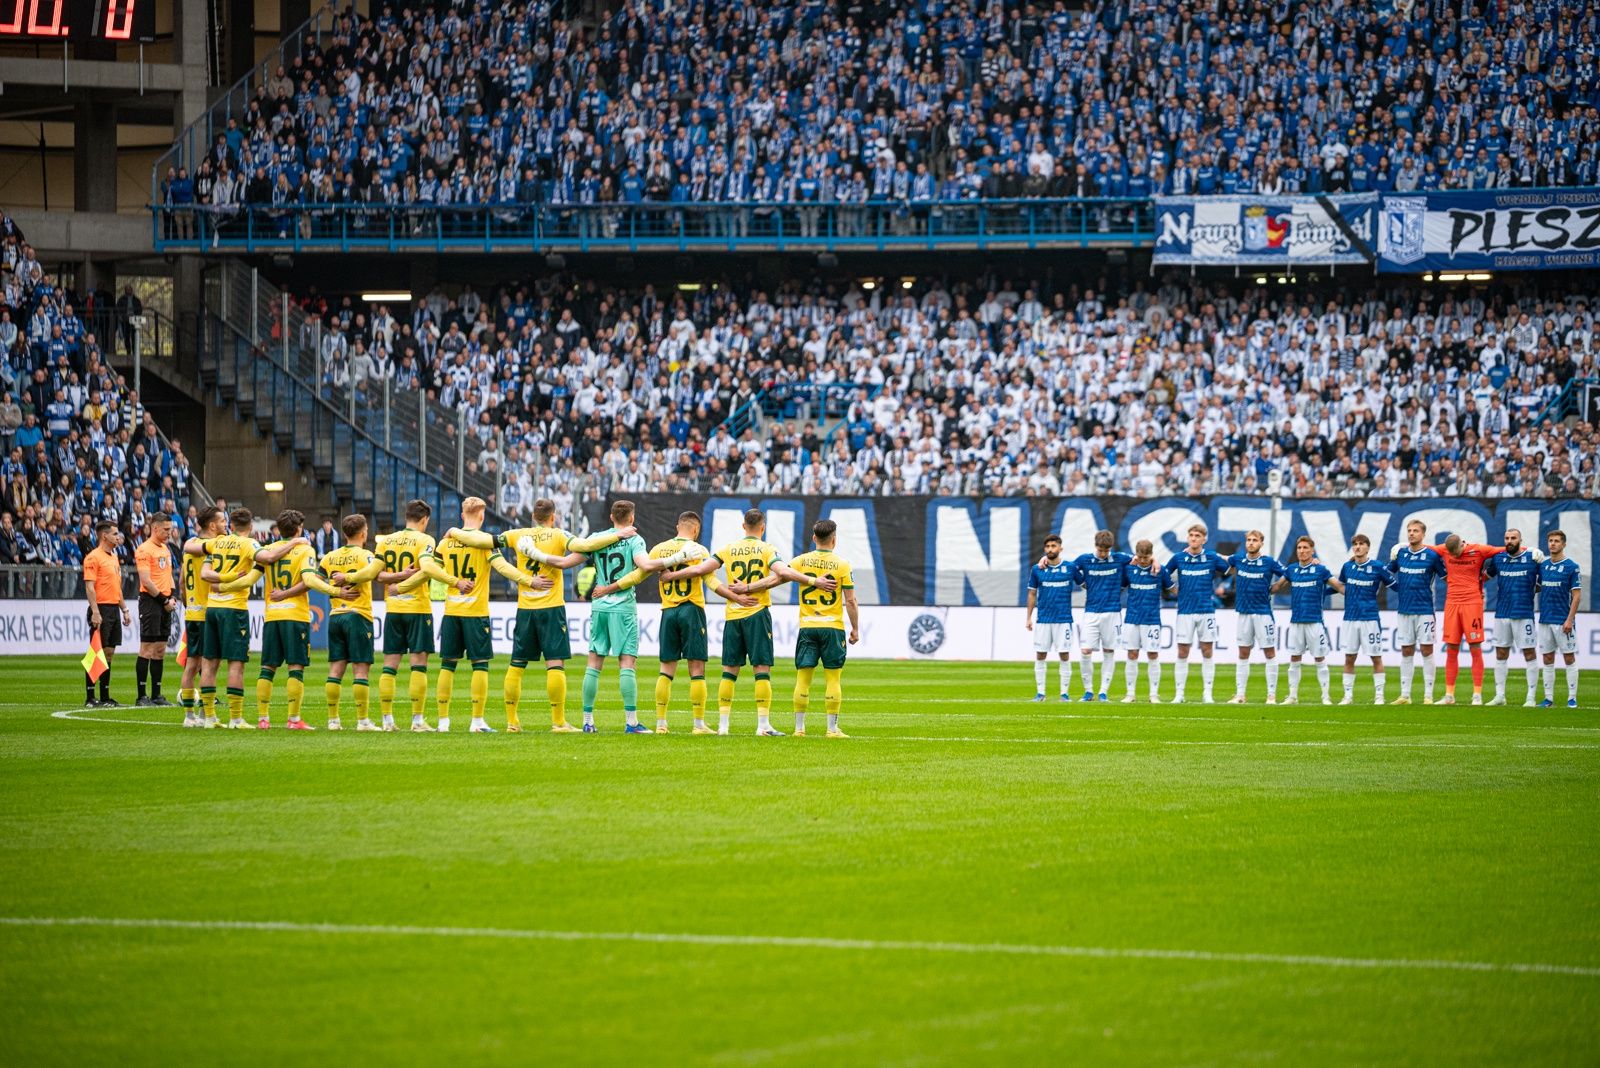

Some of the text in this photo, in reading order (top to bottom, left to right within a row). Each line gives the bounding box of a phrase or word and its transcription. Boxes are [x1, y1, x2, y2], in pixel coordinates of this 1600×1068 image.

[730, 545, 764, 558] RASAK
[328, 554, 359, 567] MILEWSKI
[800, 557, 839, 571] WASIELEWSKI
[186, 557, 196, 591] 8
[448, 553, 477, 582] 14
[598, 551, 626, 586] 12
[730, 558, 765, 585] 26
[1088, 568, 1118, 577] SUPERBET
[1181, 569, 1210, 577] SUPERBET
[1237, 569, 1265, 579] SUPERBET
[1400, 566, 1427, 575] SUPERBET
[270, 559, 293, 592] 15
[1347, 577, 1375, 587] SUPERBET
[1041, 580, 1070, 588] SUPERBET
[1291, 580, 1317, 588] SUPERBET
[1264, 624, 1275, 636] 15
[1423, 621, 1436, 634] 72
[1471, 618, 1483, 631] 41
[1525, 624, 1533, 637] 9
[1065, 629, 1071, 641] 8
[1147, 629, 1160, 641] 43
[1319, 634, 1325, 646] 2
[1368, 632, 1381, 645] 99
